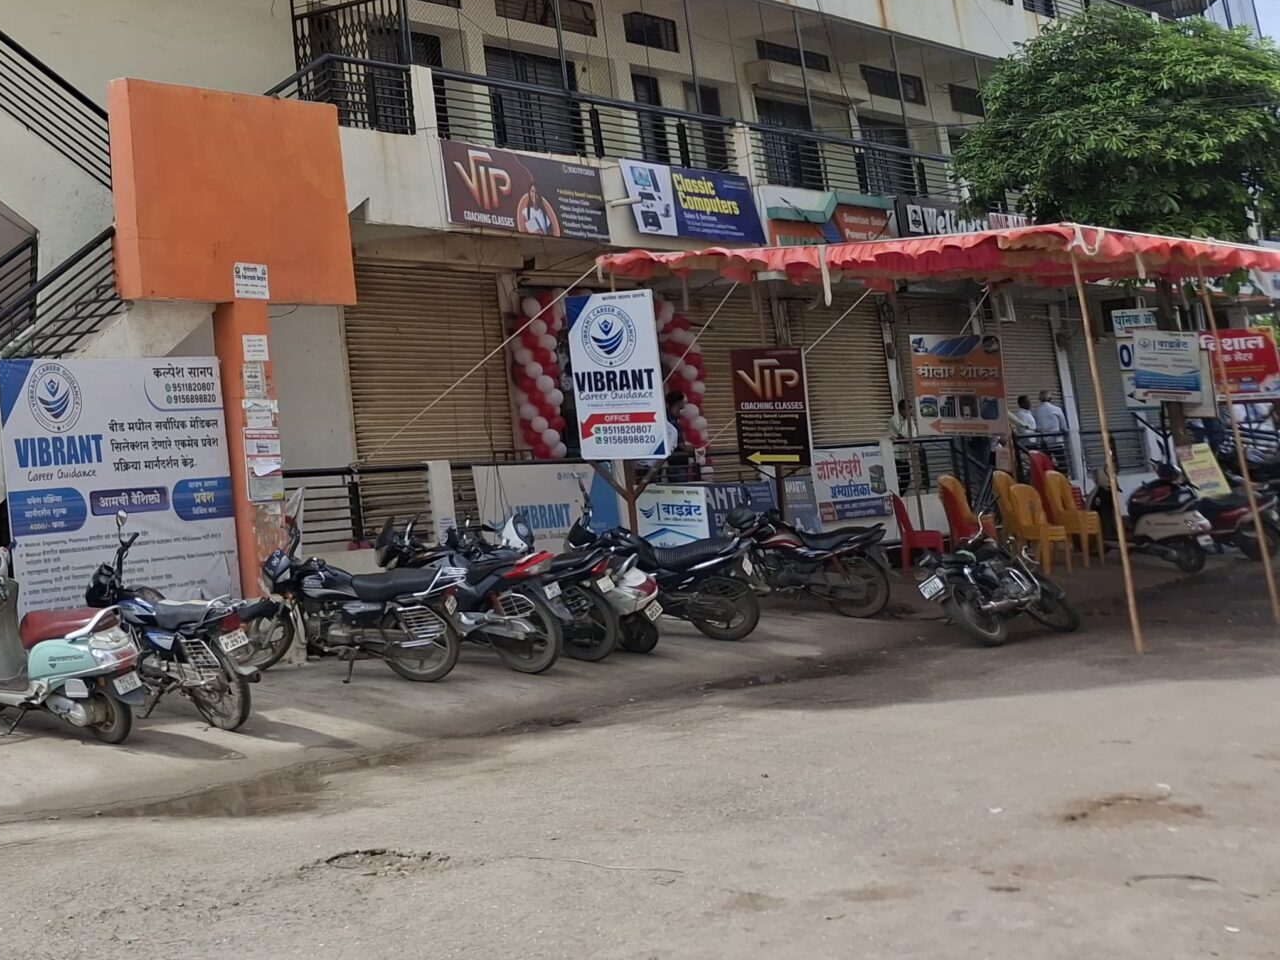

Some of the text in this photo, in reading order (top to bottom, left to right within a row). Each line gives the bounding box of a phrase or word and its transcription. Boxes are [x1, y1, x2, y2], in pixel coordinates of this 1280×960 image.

[453, 149, 512, 210] VIP
[672, 172, 716, 195] Classic
[677, 191, 740, 215] Computers
[463, 209, 515, 228] COACHING CLASSES
[592, 307, 615, 317] CAREER
[616, 310, 635, 343] GUIDANCE
[152, 363, 214, 379] कल्पेश सानप
[736, 358, 800, 400] VIP
[29, 365, 81, 408] VIBRANT CAREER GUIDANCE
[172, 382, 215, 392] 9511820807
[574, 368, 654, 392] VIBRANT
[173, 393, 217, 404] 9156898820
[579, 390, 654, 402] Career Guidance
[741, 401, 804, 410] COACHING CLASSES
[127, 418, 152, 432] मधील
[189, 416, 219, 430] मेडिकल
[604, 414, 631, 422] OFFICE
[602, 424, 652, 434] 9511820807
[110, 438, 150, 453] सिलेक्शन
[151, 436, 173, 450] देणारे
[200, 434, 219, 448] प्रवेश
[603, 434, 656, 445] 9156898820
[14, 434, 103, 468] VIBRANT
[143, 455, 180, 470] मार्गदर्शन
[27, 467, 97, 482] Career Guidance
[99, 493, 130, 509] आमची
